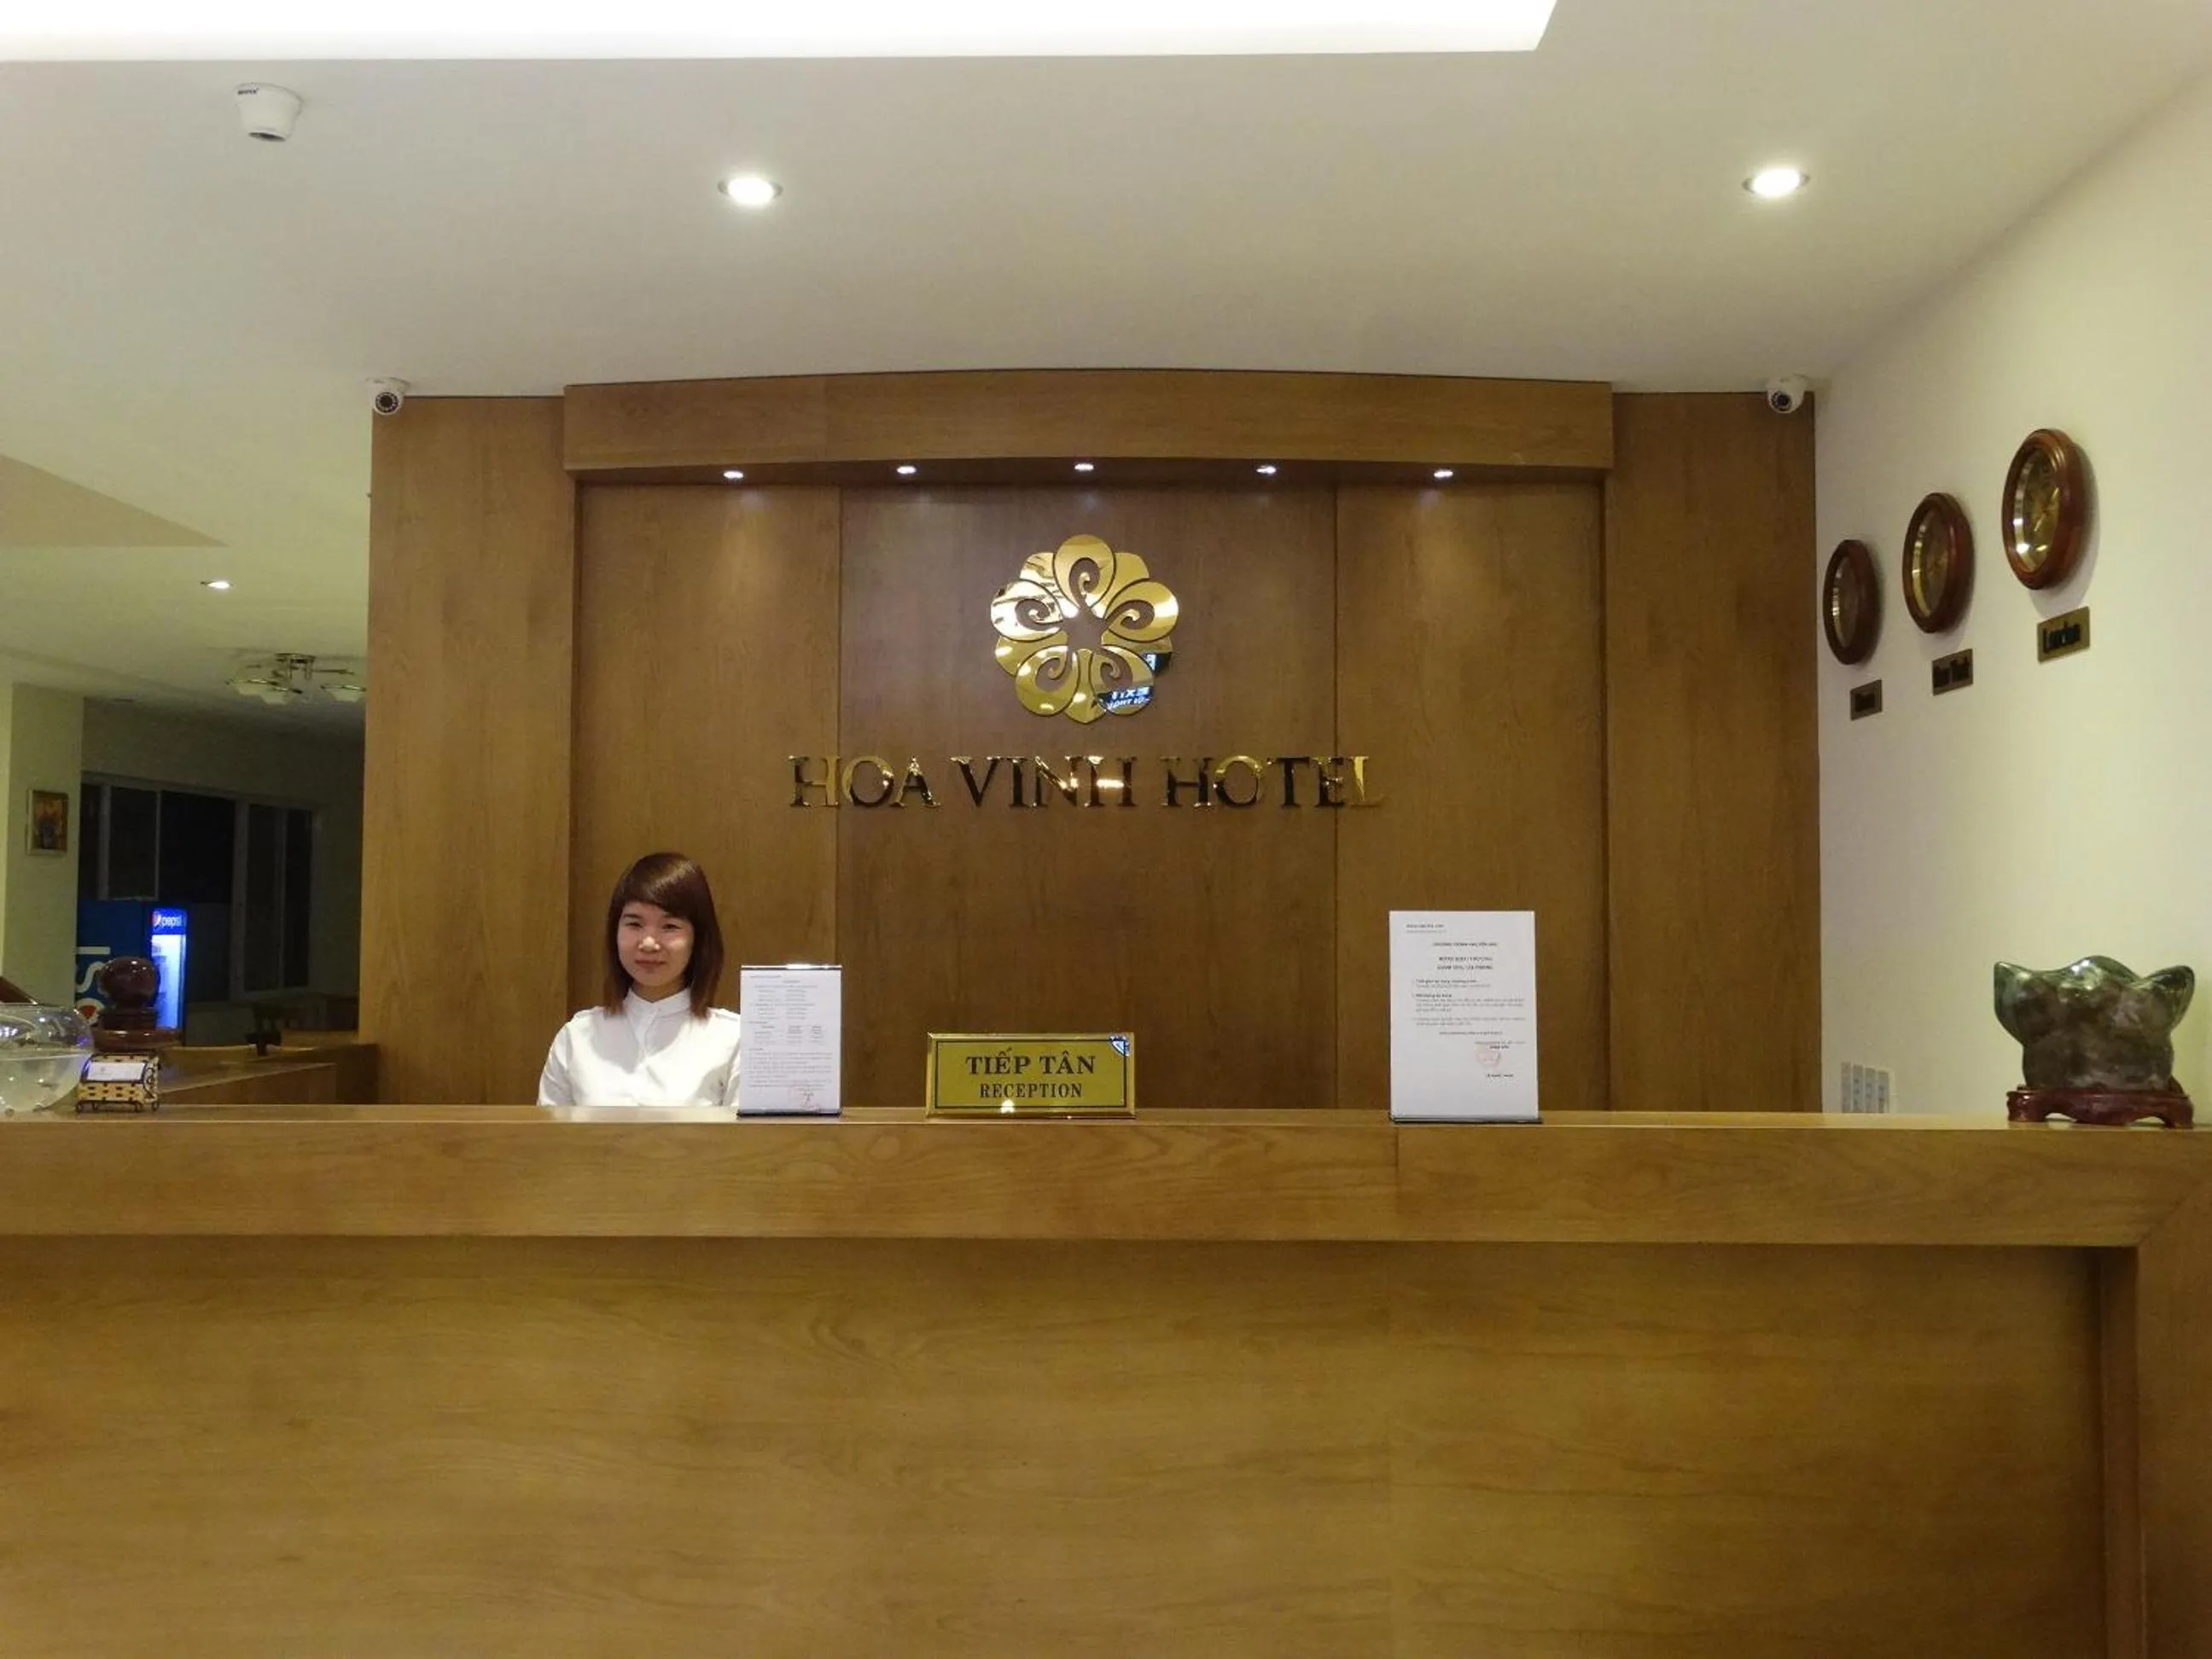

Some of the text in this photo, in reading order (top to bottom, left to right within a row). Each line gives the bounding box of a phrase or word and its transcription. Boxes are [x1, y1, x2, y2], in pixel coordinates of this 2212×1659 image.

[787, 754, 1387, 808] HOA VINH HOTEL
[966, 1047, 1096, 1075] TIẾP TÂN
[980, 1082, 1083, 1098] RECEPTION
